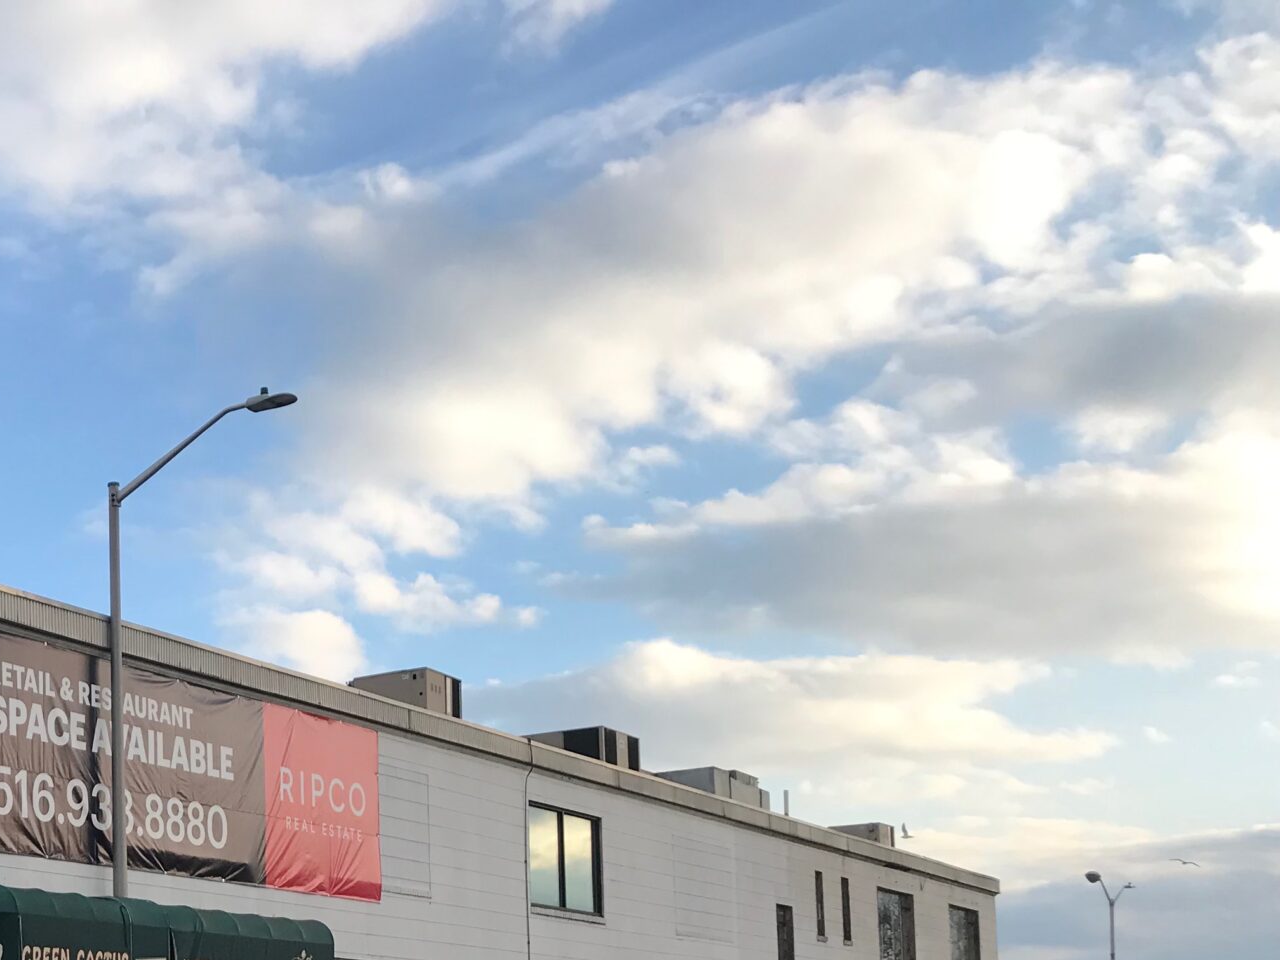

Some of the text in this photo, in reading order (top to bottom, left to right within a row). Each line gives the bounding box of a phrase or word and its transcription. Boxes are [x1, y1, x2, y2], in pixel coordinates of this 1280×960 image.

[60, 677, 74, 703] &
[78, 680, 194, 730] RESAURANT
[279, 766, 366, 817] RIPCO
[285, 816, 363, 842] REAL ESTATE
